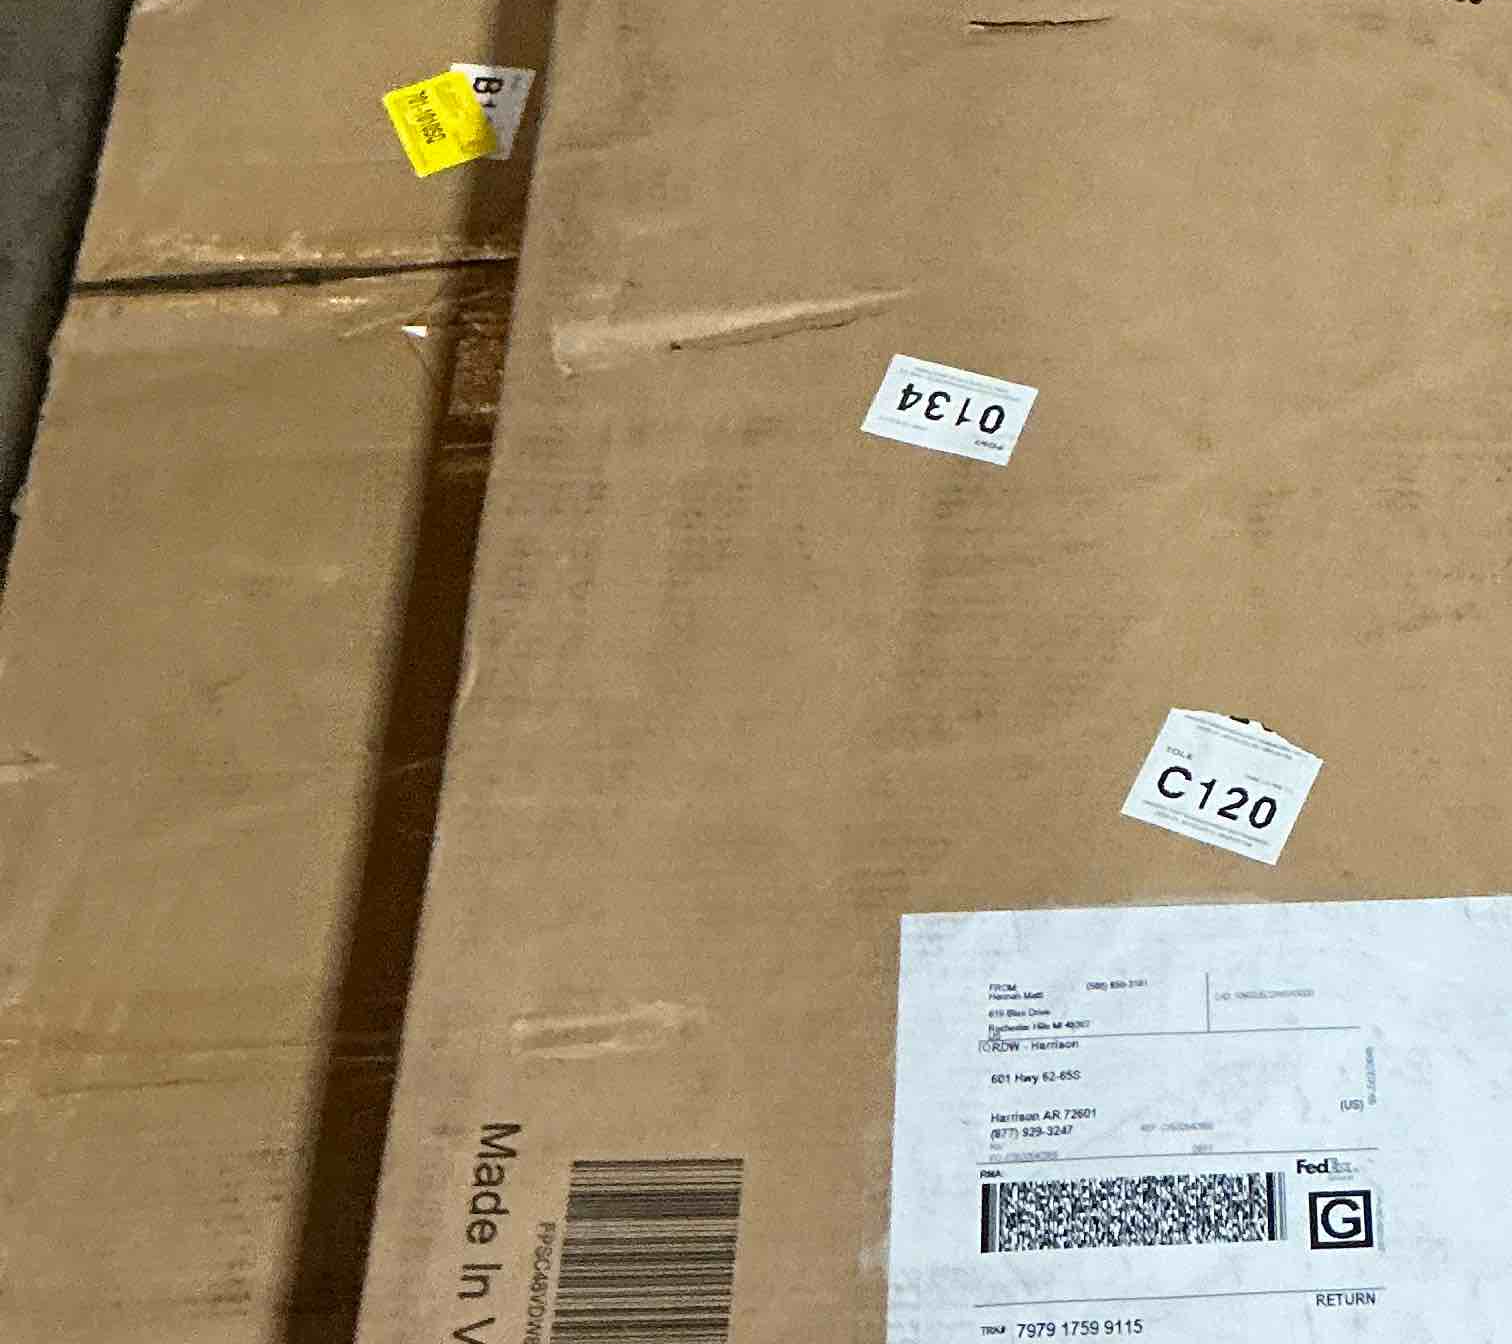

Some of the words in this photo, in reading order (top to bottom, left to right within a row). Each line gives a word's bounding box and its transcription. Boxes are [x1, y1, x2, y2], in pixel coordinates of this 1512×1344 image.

[897, 382, 1006, 434] 0134
[1157, 766, 1277, 829] C120
[1032, 1040, 1079, 1050] Harrison
[1015, 1073, 1039, 1086] Hwy
[1340, 1099, 1365, 1112] (US)
[990, 1112, 1040, 1124] Harrison
[1043, 1111, 1061, 1121] AR
[1064, 1108, 1097, 1120] 72601
[990, 1128, 1020, 1140] (877)
[466, 1122, 522, 1244] Made
[1321, 1198, 1362, 1239] G
[457, 1263, 503, 1300] In
[1315, 1293, 1377, 1307] RETURN
[1017, 1323, 1056, 1339] 7979
[1062, 1321, 1100, 1337] 1759
[1104, 1319, 1144, 1335] 9115
